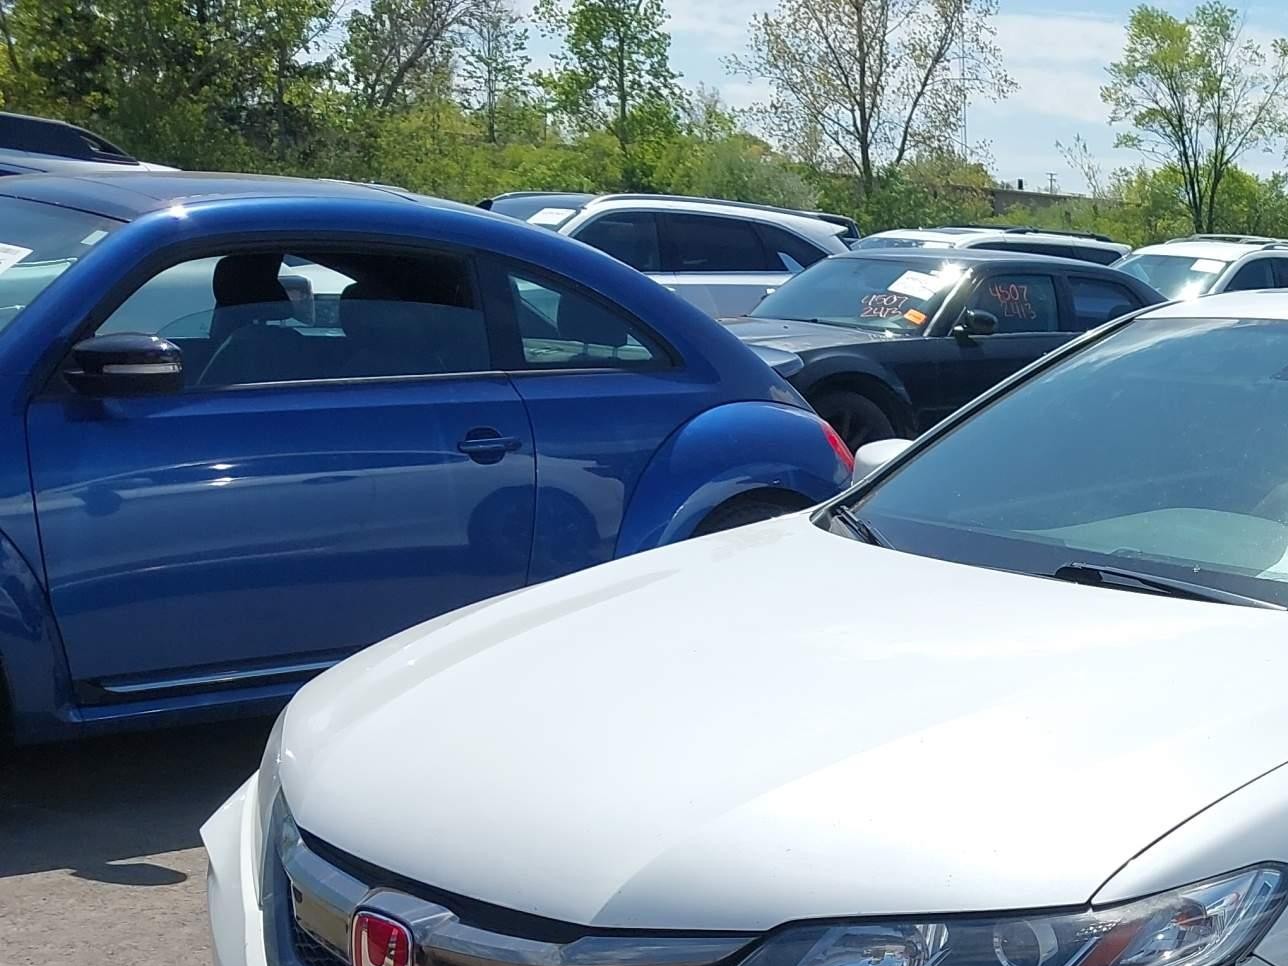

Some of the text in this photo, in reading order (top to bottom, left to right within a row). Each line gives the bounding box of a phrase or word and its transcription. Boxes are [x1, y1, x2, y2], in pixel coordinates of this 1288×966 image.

[990, 284, 1028, 301] 4507
[861, 294, 908, 308] 4507
[1001, 303, 1037, 319] 2413
